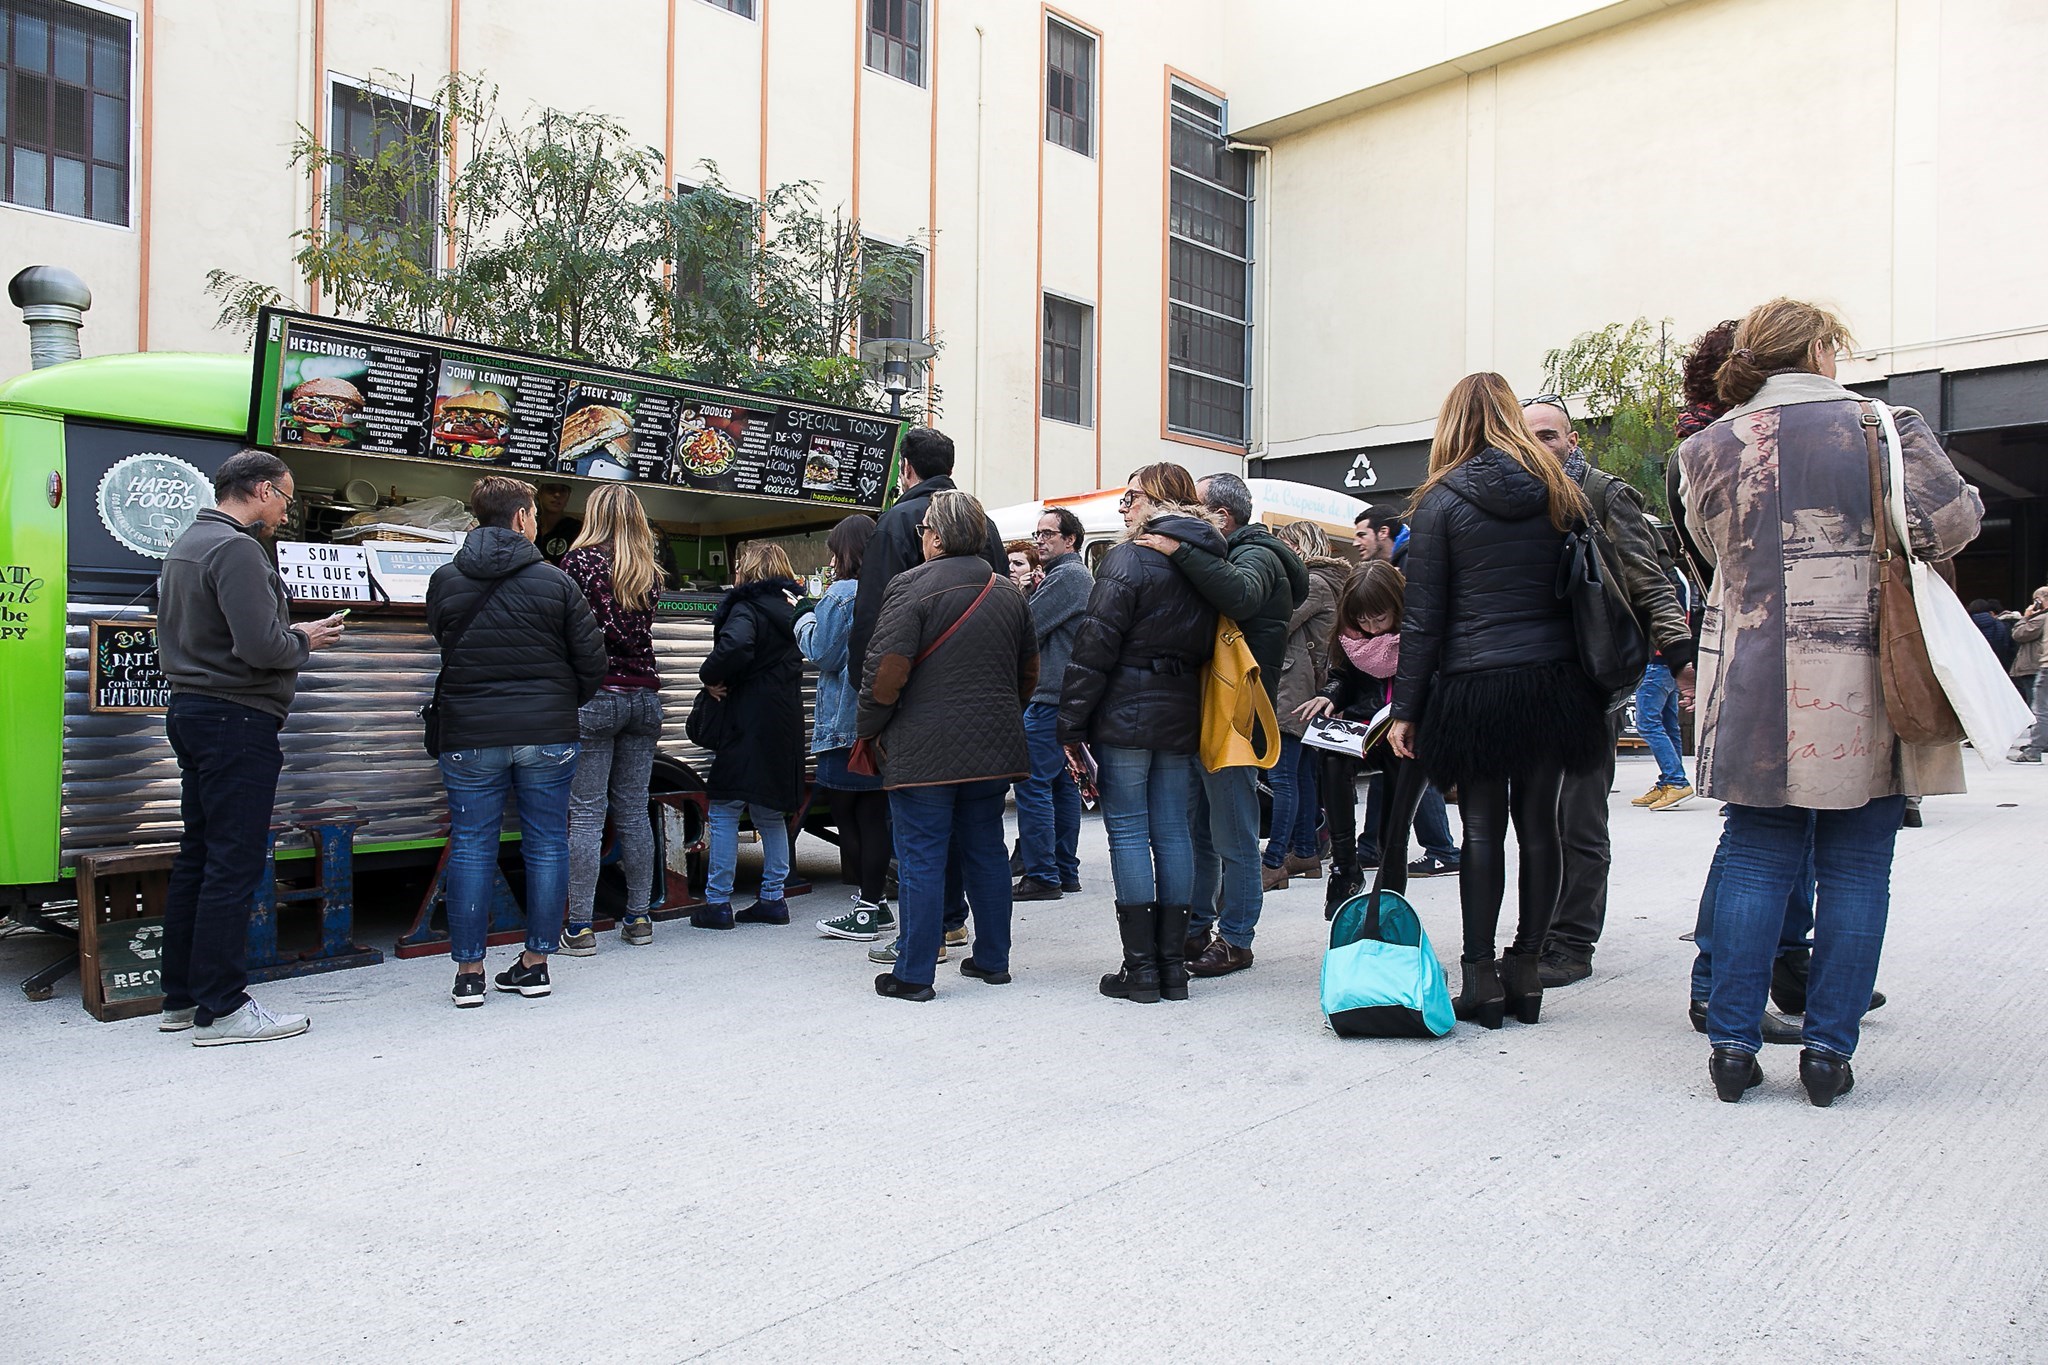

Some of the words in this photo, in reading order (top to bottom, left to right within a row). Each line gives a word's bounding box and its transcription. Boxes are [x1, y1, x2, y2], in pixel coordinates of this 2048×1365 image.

[290, 337, 367, 359] HEISENBERG
[405, 366, 423, 374] CRUNCH
[447, 366, 475, 380] JOHN
[479, 372, 518, 387] LENNON
[401, 380, 417, 388] PORRO
[442, 351, 460, 359] TOTS
[476, 357, 507, 368] NOSTRES
[509, 364, 553, 375] INGREDIENTS
[655, 386, 672, 394] SENSE
[674, 389, 696, 397] GLUTEN
[709, 394, 723, 402] HAVE
[725, 398, 746, 406] GLUTEN
[581, 386, 608, 399] STEVE
[611, 391, 632, 402] JOBS
[699, 405, 732, 418] ZOODLES
[848, 418, 887, 441] TODAY
[863, 446, 886, 459] LOVE
[860, 459, 884, 473] FOOD
[127, 476, 194, 496] HAPPY
[764, 484, 783, 495] 100%
[125, 492, 196, 510] FOODS
[813, 493, 856, 503] happyfoods.es
[1263, 484, 1279, 503] La
[1328, 501, 1340, 515] de
[134, 531, 152, 544] FOOD
[309, 548, 339, 562] SOM
[297, 566, 315, 579] EL
[323, 567, 352, 580] QUE
[289, 584, 358, 599] MENGEM!
[1, 606, 28, 622] be
[112, 652, 153, 667] DATE
[157, 680, 169, 688] LA
